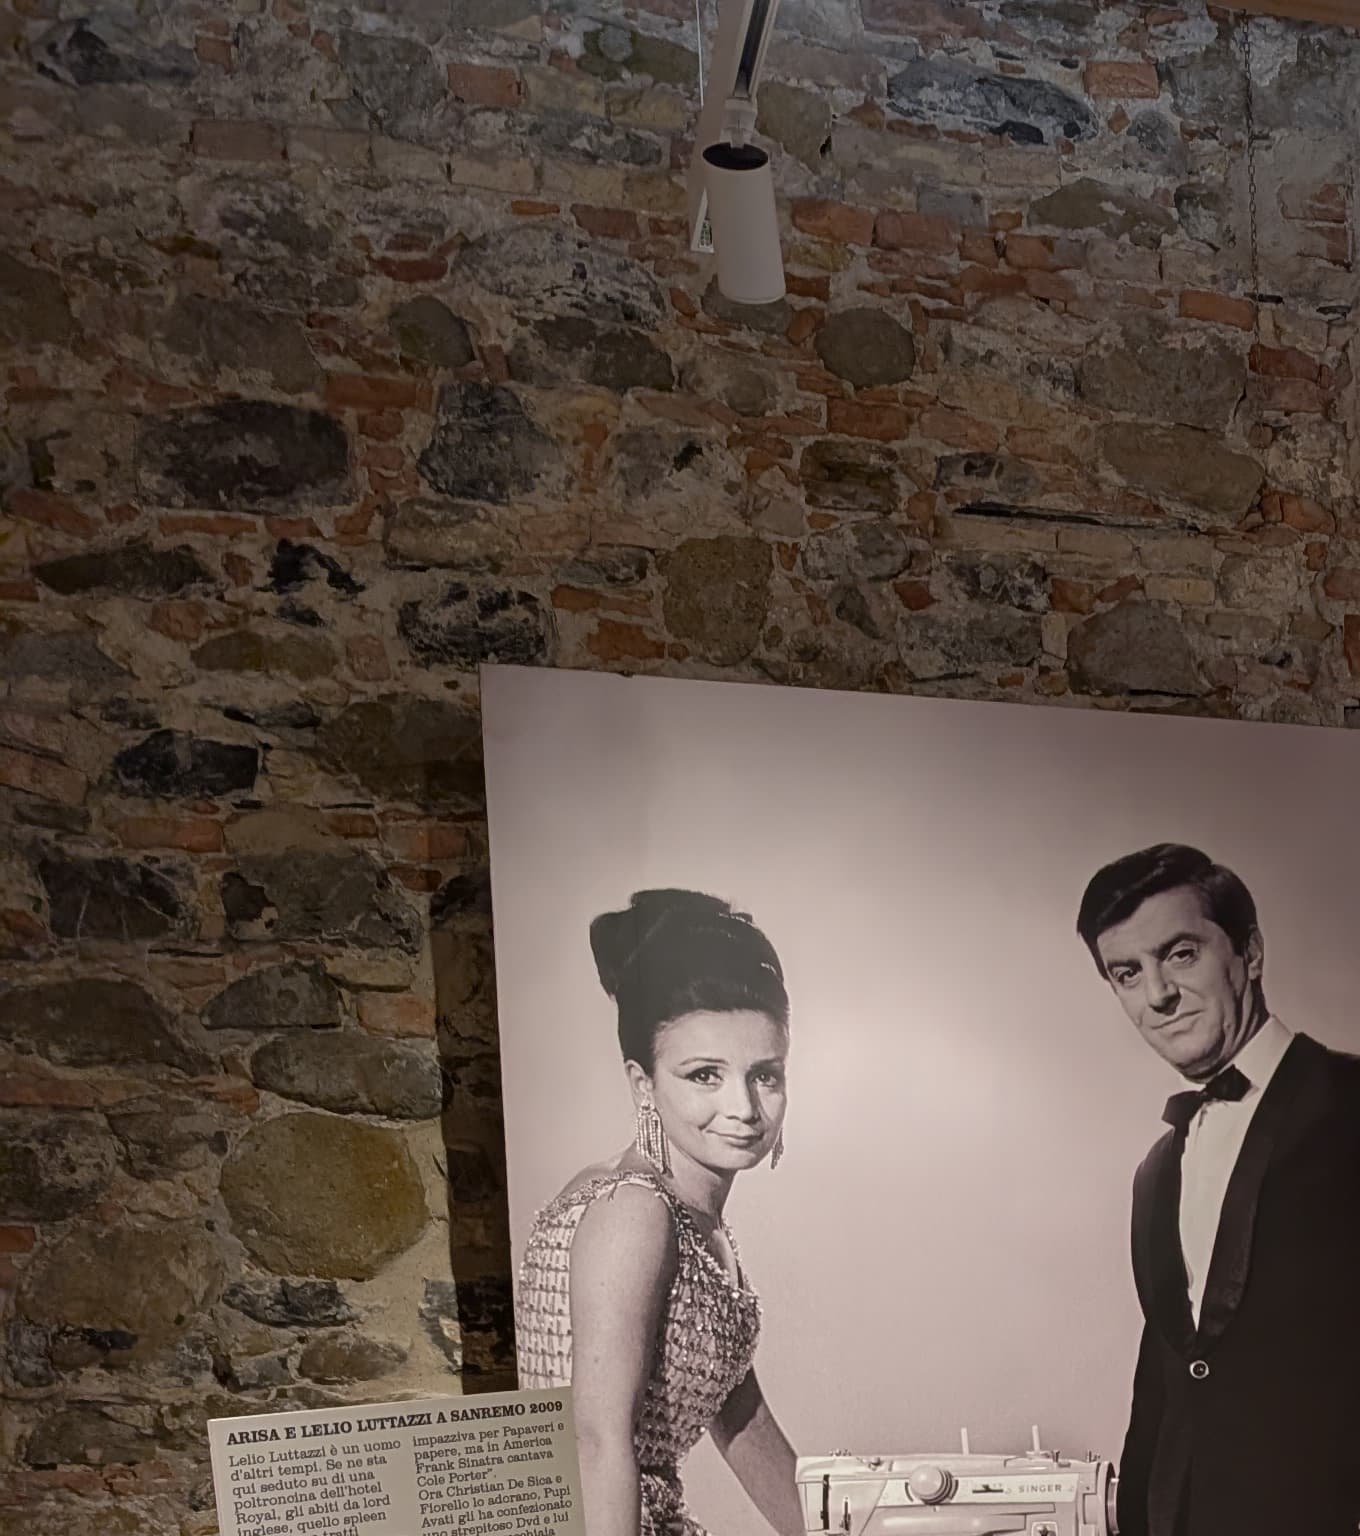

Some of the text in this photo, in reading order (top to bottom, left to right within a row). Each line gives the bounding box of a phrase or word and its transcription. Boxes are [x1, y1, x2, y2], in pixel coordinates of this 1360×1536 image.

[226, 1401, 562, 1444] ARISA E LELIO LUTTAZZI A SANREMO 2009
[412, 1431, 476, 1447] impazziva
[478, 1430, 500, 1442] per
[502, 1421, 554, 1438] Papaveri
[229, 1441, 400, 1466] Lelio Luttazzi è un uomo
[414, 1436, 552, 1462] papere, ma in America
[415, 1450, 553, 1473] Frank Sinatra cantava
[230, 1465, 273, 1481] d'altri
[326, 1459, 342, 1470] Se
[346, 1459, 363, 1468] ne
[366, 1455, 387, 1466] sta
[232, 1471, 375, 1498] qui seduto su di una
[1018, 1484, 1062, 1493] SINGER
